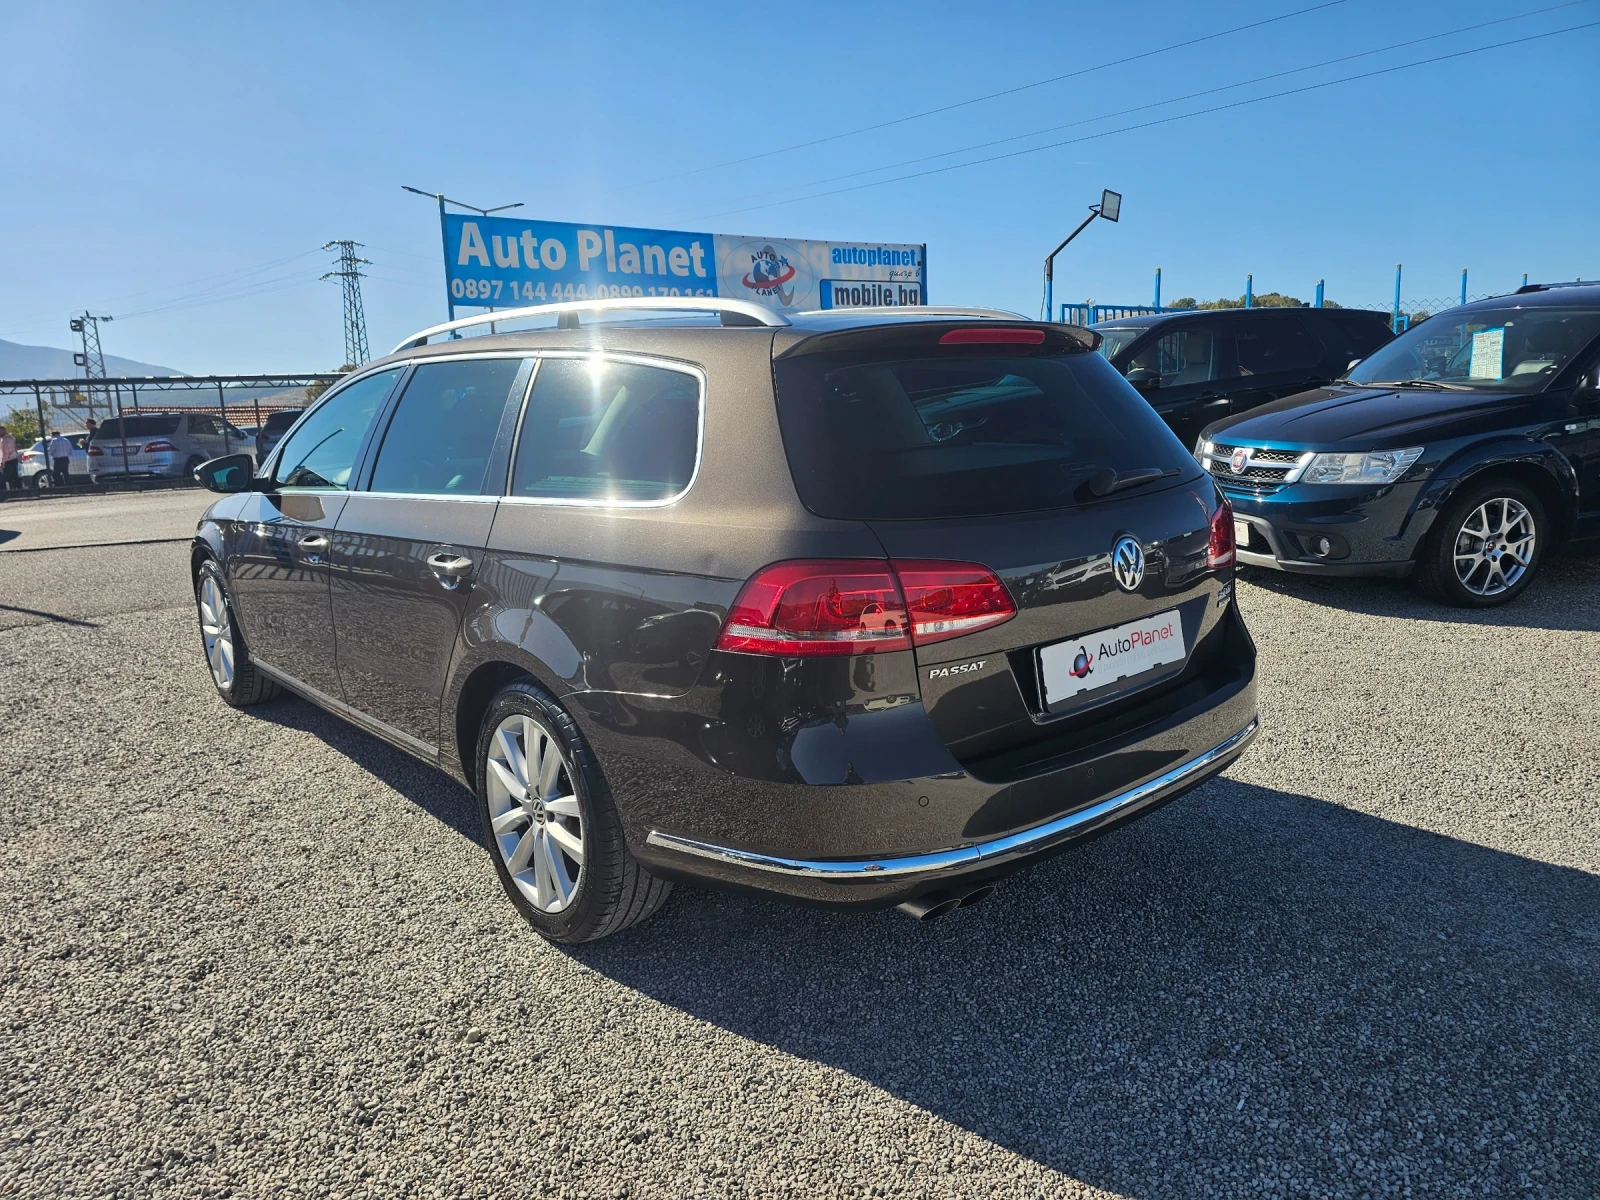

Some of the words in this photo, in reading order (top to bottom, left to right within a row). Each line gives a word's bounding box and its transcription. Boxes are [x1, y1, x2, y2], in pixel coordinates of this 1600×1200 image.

[457, 222, 567, 271] Auto
[576, 229, 707, 278] Planet
[751, 251, 776, 263] AUTO
[451, 278, 503, 299] 0897
[509, 281, 547, 301] 144
[751, 283, 781, 297] PLANET
[834, 284, 918, 306] mobile.bg
[1098, 622, 1174, 661] AutoPlanet
[929, 660, 986, 679] PASSAT
